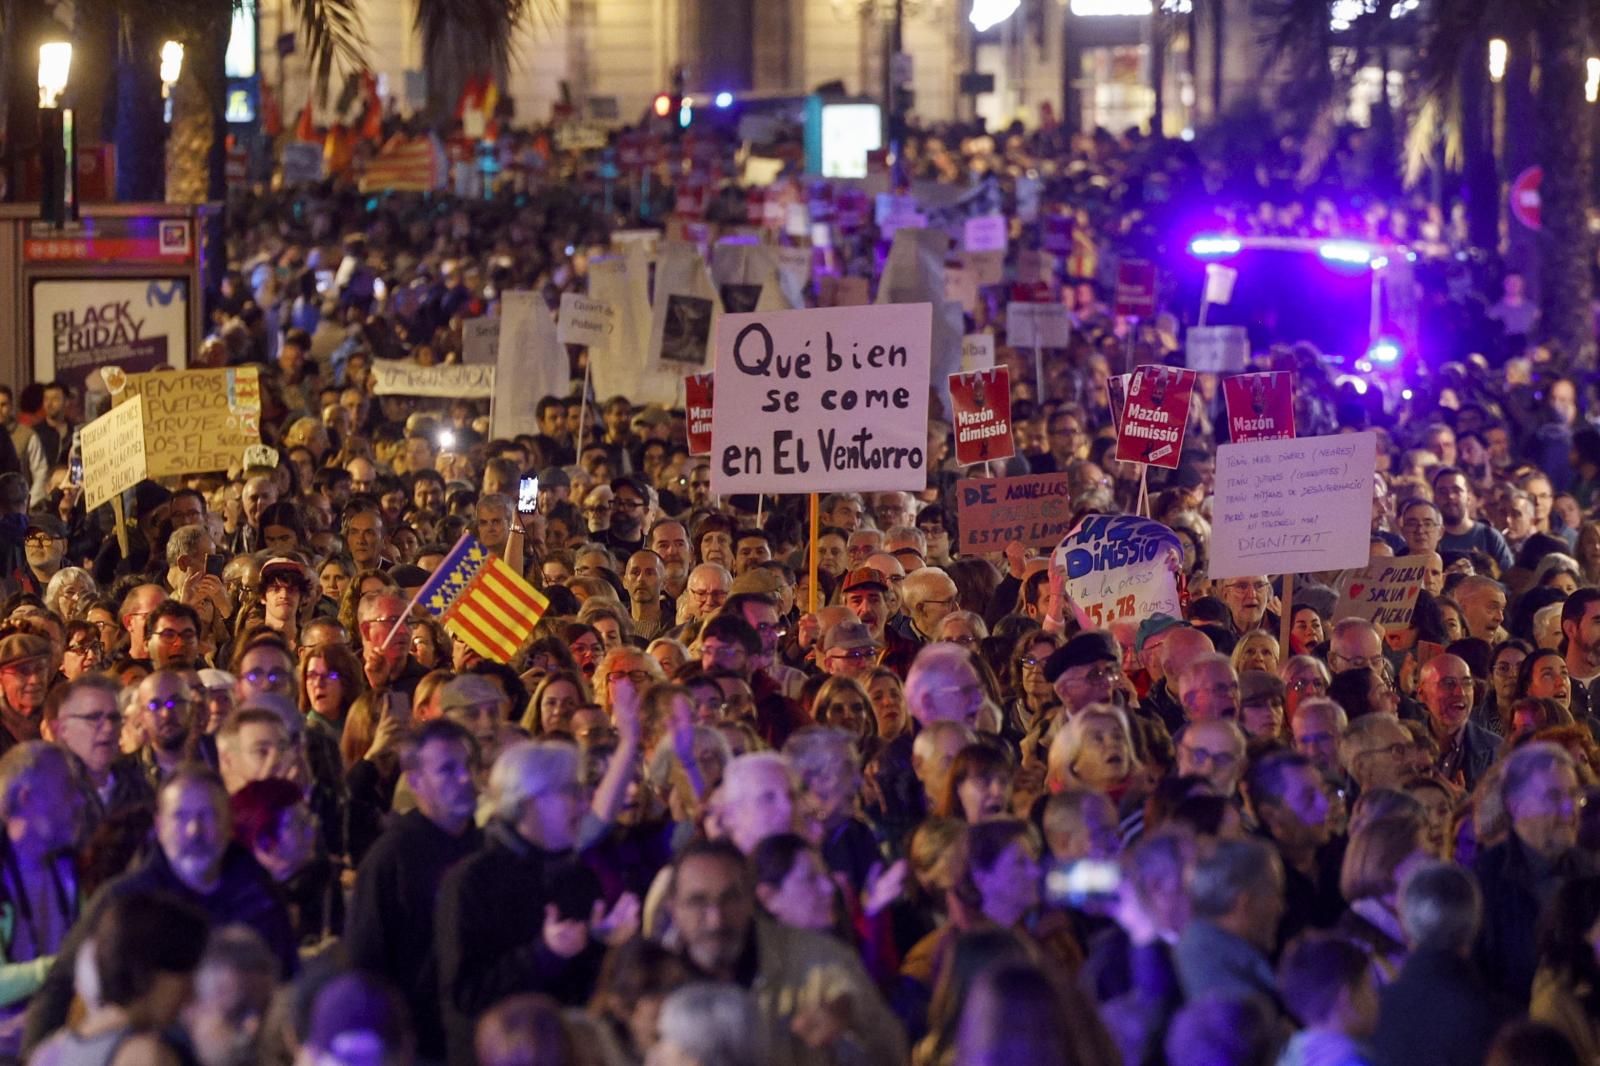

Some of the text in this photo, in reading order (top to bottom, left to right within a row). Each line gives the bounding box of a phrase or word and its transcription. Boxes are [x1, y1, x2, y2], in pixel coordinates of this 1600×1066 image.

[54, 300, 131, 330] BLACK
[54, 319, 145, 353] FRIDAY
[733, 322, 907, 379] Qué bien
[124, 374, 222, 398] MIENTRAS
[148, 394, 228, 421] PUEBLO
[761, 387, 910, 413] se come
[957, 407, 994, 427] Mazón
[1128, 403, 1169, 423] Mazón
[1233, 414, 1274, 431] Mazón
[959, 419, 1007, 443] dimissió
[1125, 421, 1179, 443] dimissió
[722, 427, 923, 477] en El Ventorro
[963, 484, 997, 507] DE
[968, 525, 1025, 545] ESTOS
[1367, 587, 1406, 602] SALVA
